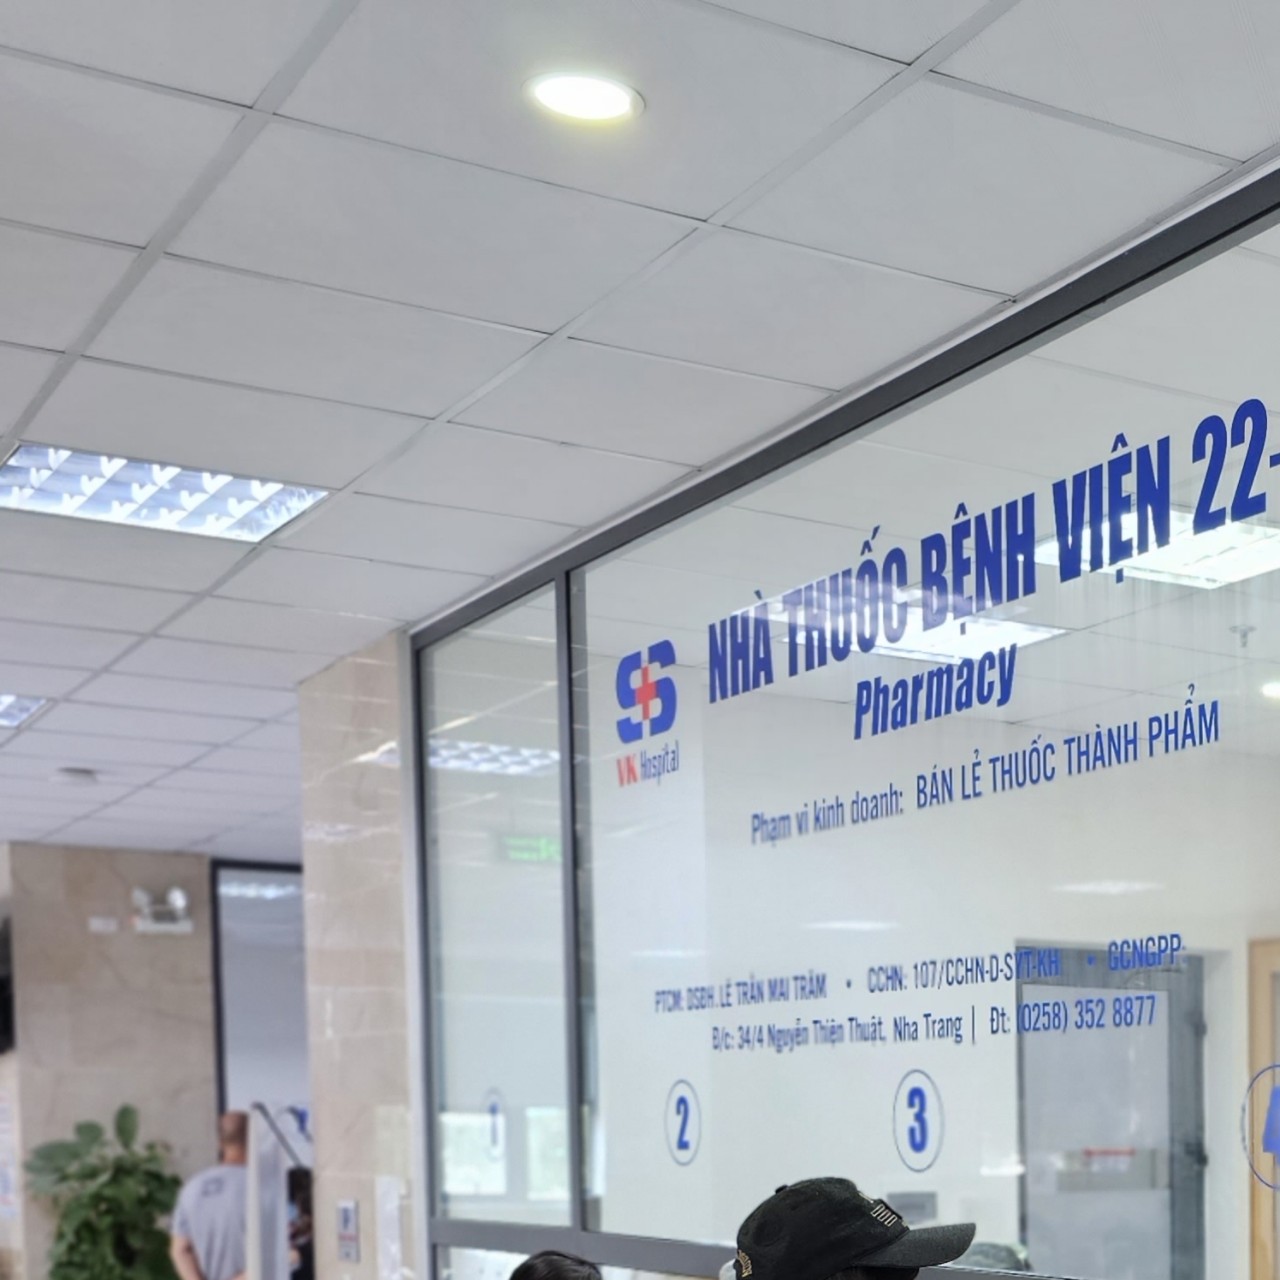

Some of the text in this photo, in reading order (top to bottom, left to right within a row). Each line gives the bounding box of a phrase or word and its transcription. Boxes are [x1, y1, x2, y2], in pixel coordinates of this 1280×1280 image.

[708, 589, 774, 704] NHÀ
[782, 525, 909, 678] THUỐC
[920, 502, 1036, 635] BỆNH
[1052, 433, 1172, 584] VIỆN
[853, 642, 1018, 741] Pharmacy
[616, 739, 680, 787] VK Hospital
[751, 682, 1220, 847] Phạm vi kinh doanh: BÁN LẺ THUỐC THÀNH PHẨM
[766, 976, 790, 1003] MAI
[737, 1024, 764, 1051] 34/4
[767, 1016, 810, 1054] Nguyễn
[811, 1017, 845, 1047] Thiện
[893, 1015, 919, 1042] Nha
[922, 1011, 964, 1044] Trang
[1016, 1000, 1068, 1034] (0258)
[1074, 998, 1106, 1029] 352
[1112, 994, 1156, 1026] 8877
[676, 1095, 691, 1152] 2
[907, 1086, 929, 1155] 3
